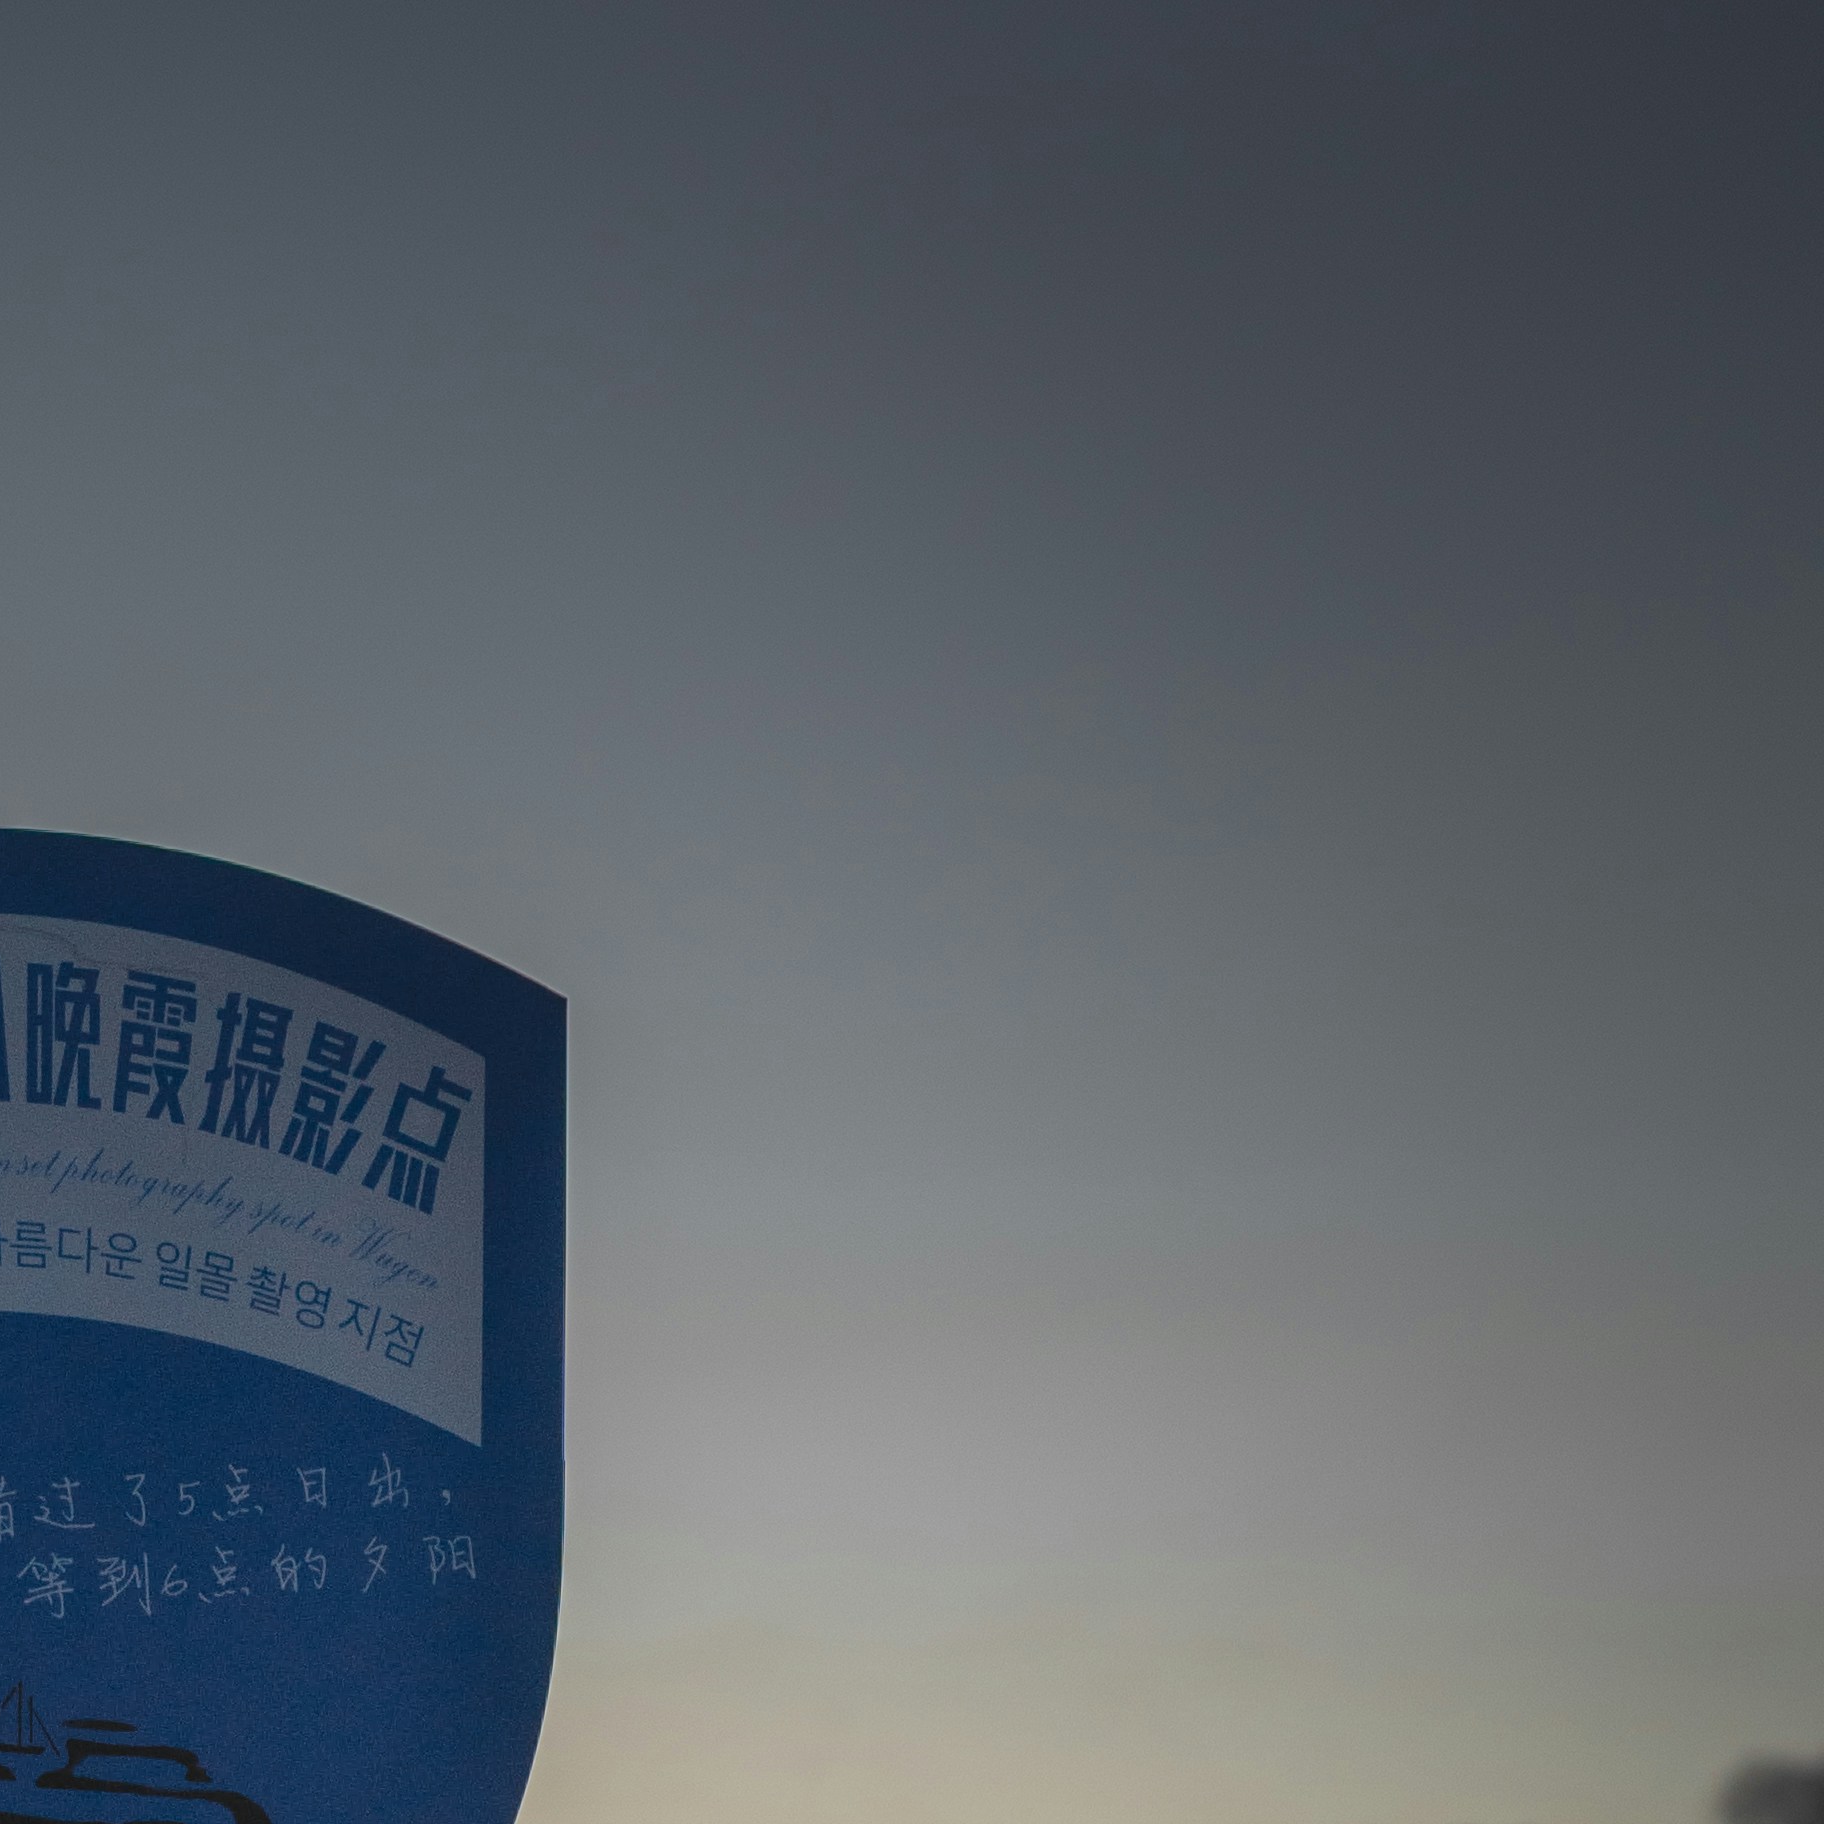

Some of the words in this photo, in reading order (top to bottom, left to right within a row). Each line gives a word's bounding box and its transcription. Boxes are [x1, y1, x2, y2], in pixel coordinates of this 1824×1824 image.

[50, 1147, 246, 1229] photography
[247, 1200, 317, 1235] spot
[312, 1223, 342, 1248] in
[154, 1239, 238, 1303] 일몰
[245, 1263, 333, 1331] 촬영
[337, 1297, 426, 1369] 지점
